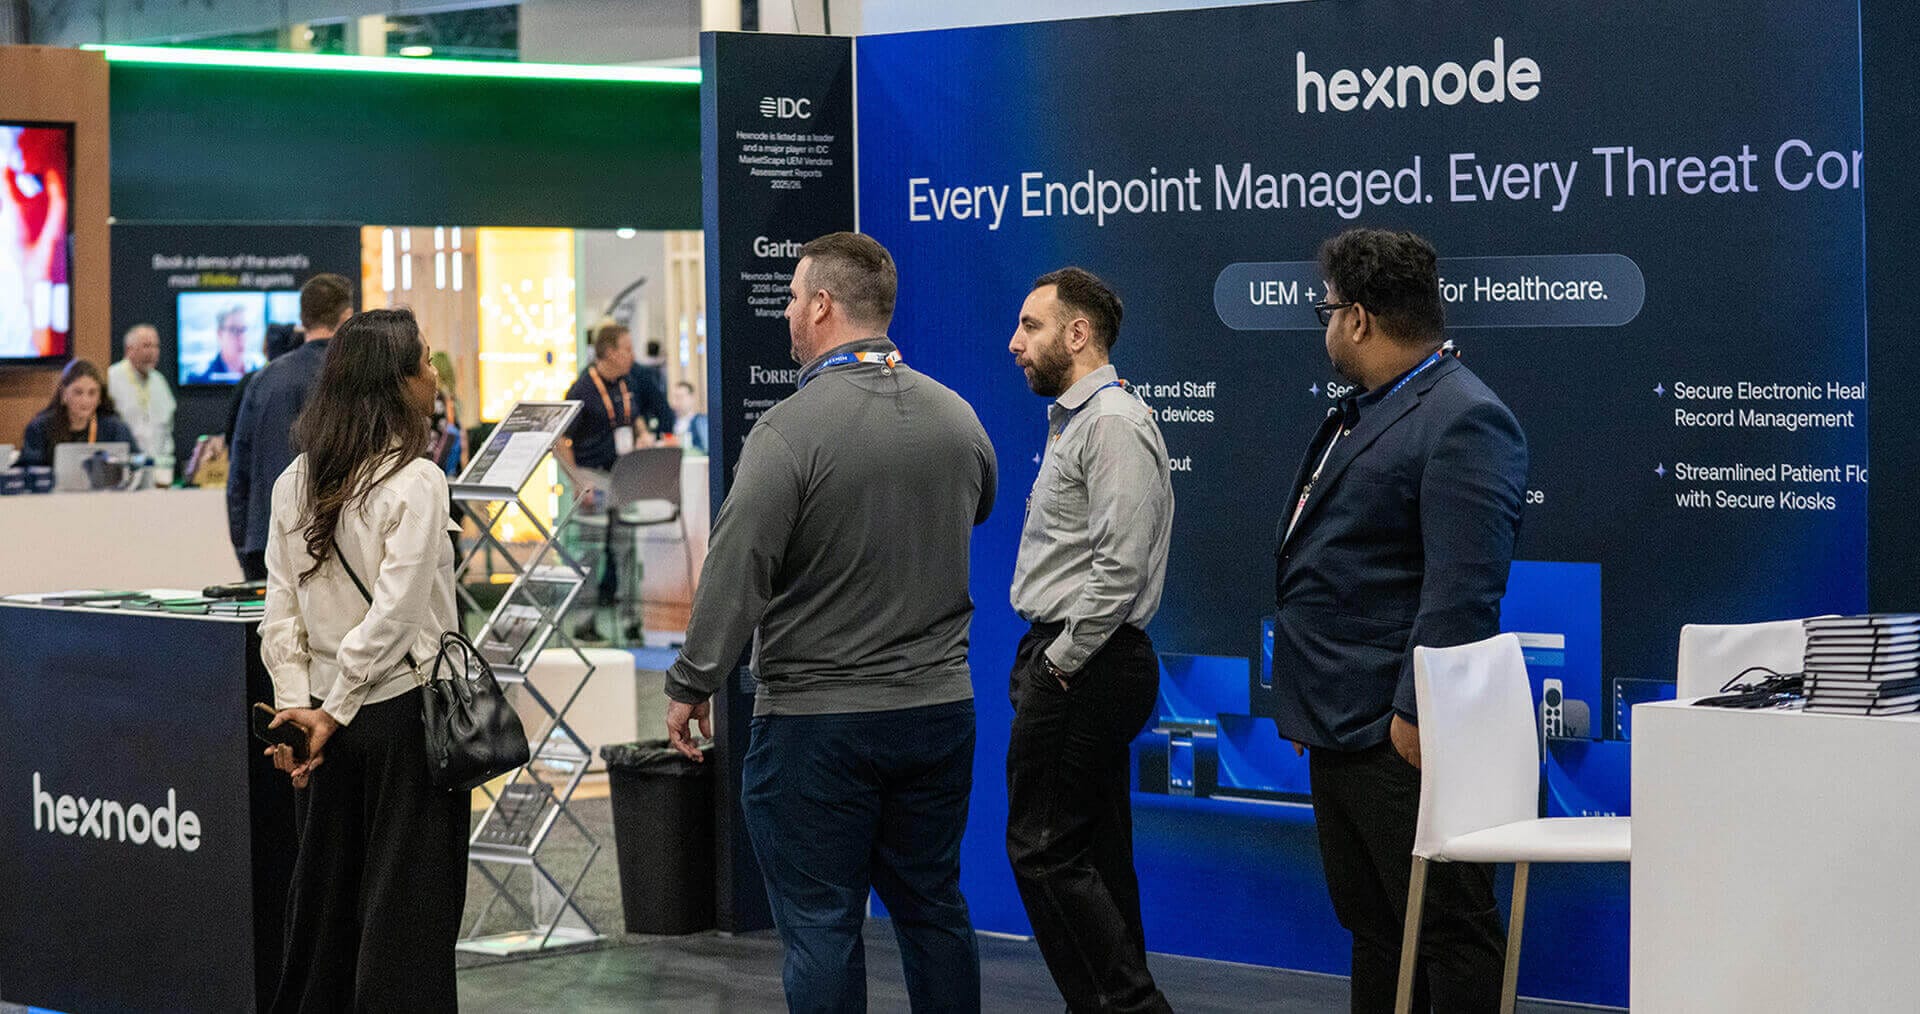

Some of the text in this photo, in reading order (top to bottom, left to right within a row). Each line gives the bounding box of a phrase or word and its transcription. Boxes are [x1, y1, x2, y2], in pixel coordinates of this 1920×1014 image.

[1296, 36, 1541, 113] hexnode
[777, 96, 811, 118] IDC
[736, 131, 768, 141] Hexnode
[777, 132, 796, 142] listed
[813, 133, 834, 143] leader
[743, 144, 758, 152] and
[764, 145, 784, 155] major
[786, 145, 806, 155] player
[816, 145, 829, 154] IDC
[739, 155, 785, 167] MarketScape
[804, 158, 833, 167] Vendors
[750, 168, 822, 179] Assessment Reports
[909, 178, 1009, 230] Every
[1021, 167, 1202, 226] Endpoint
[1215, 155, 1434, 219] Managed.
[1450, 153, 1579, 212] Every
[1592, 145, 1759, 197] Threat
[1250, 280, 1298, 305] UEM
[1304, 287, 1317, 302] +
[1438, 277, 1467, 302] for
[1474, 275, 1608, 301] Healthcare.
[1154, 381, 1181, 398] and
[1183, 381, 1216, 398] Staff
[1674, 382, 1867, 400] Secure Electronic Heal
[1161, 405, 1215, 422] devices
[1675, 409, 1854, 431] Record Management
[1675, 462, 1776, 481] Streamlined
[1781, 463, 1842, 483] Patient
[1675, 490, 1836, 510] with Secure Kiosks
[33, 771, 201, 852] hexnode
